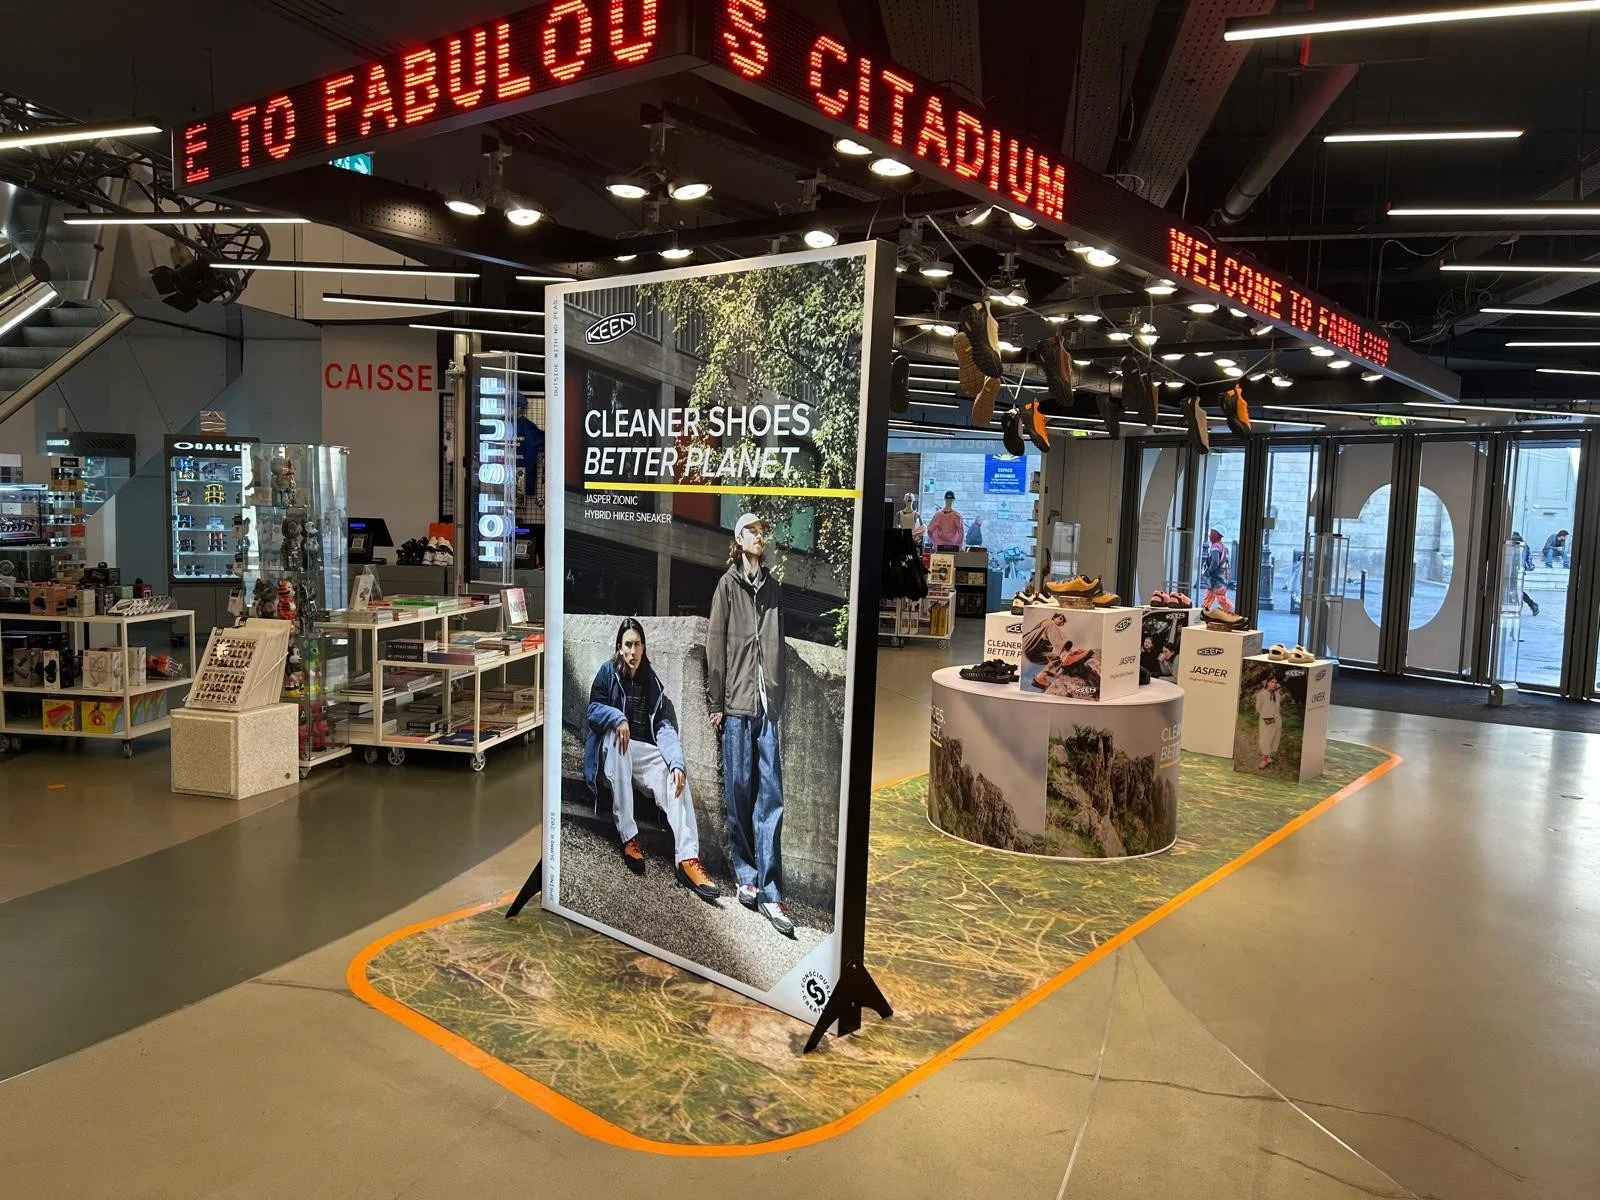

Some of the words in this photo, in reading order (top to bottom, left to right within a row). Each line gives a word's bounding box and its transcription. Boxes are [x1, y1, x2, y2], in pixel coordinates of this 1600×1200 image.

[232, 95, 296, 168] TO
[809, 35, 1066, 222] CITADIUM
[1169, 227, 1283, 320] WELCOME
[1289, 289, 1313, 333] TO
[1318, 306, 1389, 368] FABULOUS
[587, 315, 635, 342] KEEN
[324, 362, 433, 392] CAISSE
[478, 377, 505, 485] STUFF
[584, 408, 700, 438] CLEANER
[195, 442, 242, 452] OAKLE
[584, 447, 678, 476] BETTER
[685, 447, 800, 480] PLANET.
[585, 494, 611, 504] JASPER
[612, 495, 639, 506] ZIONIC
[584, 510, 612, 520] HYBRID
[613, 511, 635, 521] HIKER
[636, 512, 672, 524] SNEAKER
[478, 494, 504, 562] HOT
[1115, 616, 1132, 632] KEEN
[986, 648, 1015, 657] BETTER
[987, 640, 1022, 650] CLEANER
[1198, 647, 1225, 656] KEEN
[1118, 655, 1136, 666] JASPER
[1189, 665, 1228, 677] JASPER
